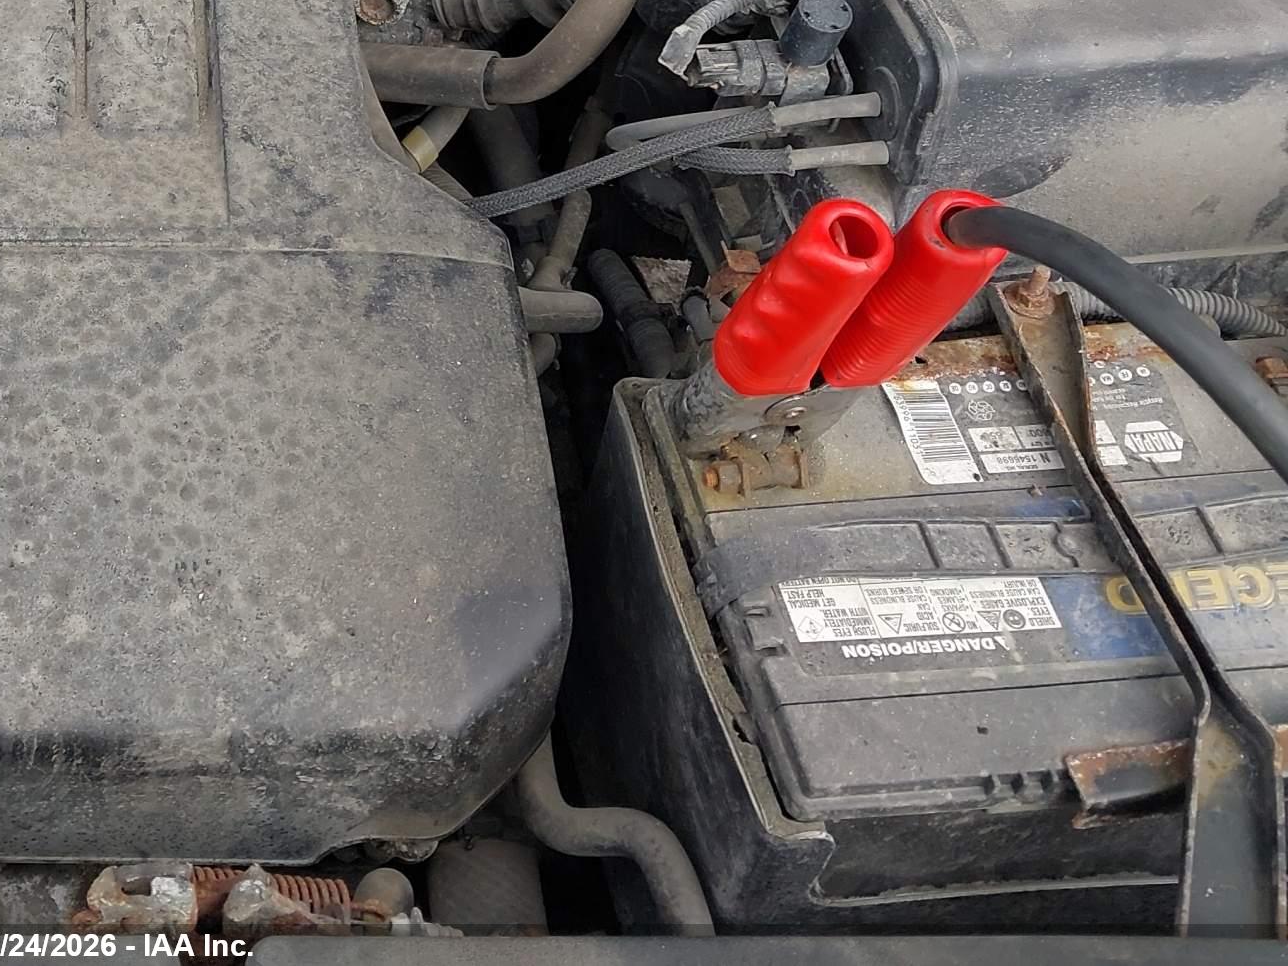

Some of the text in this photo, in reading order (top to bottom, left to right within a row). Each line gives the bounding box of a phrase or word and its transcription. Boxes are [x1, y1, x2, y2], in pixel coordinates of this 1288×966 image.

[1132, 431, 1175, 452] NAPA
[1039, 453, 1051, 463] N
[806, 589, 824, 598] HELP
[787, 598, 836, 609] GET MEDICAL
[1003, 597, 1046, 608] EXPLOSIVE
[848, 608, 867, 617] WITH
[916, 611, 934, 620] ACID
[824, 617, 872, 628] IMMEDIATELY
[903, 622, 940, 633] SULFURIC
[967, 621, 978, 630] NO
[832, 626, 876, 638] FLUSH EYES
[841, 637, 995, 659] DANGER/POISON
